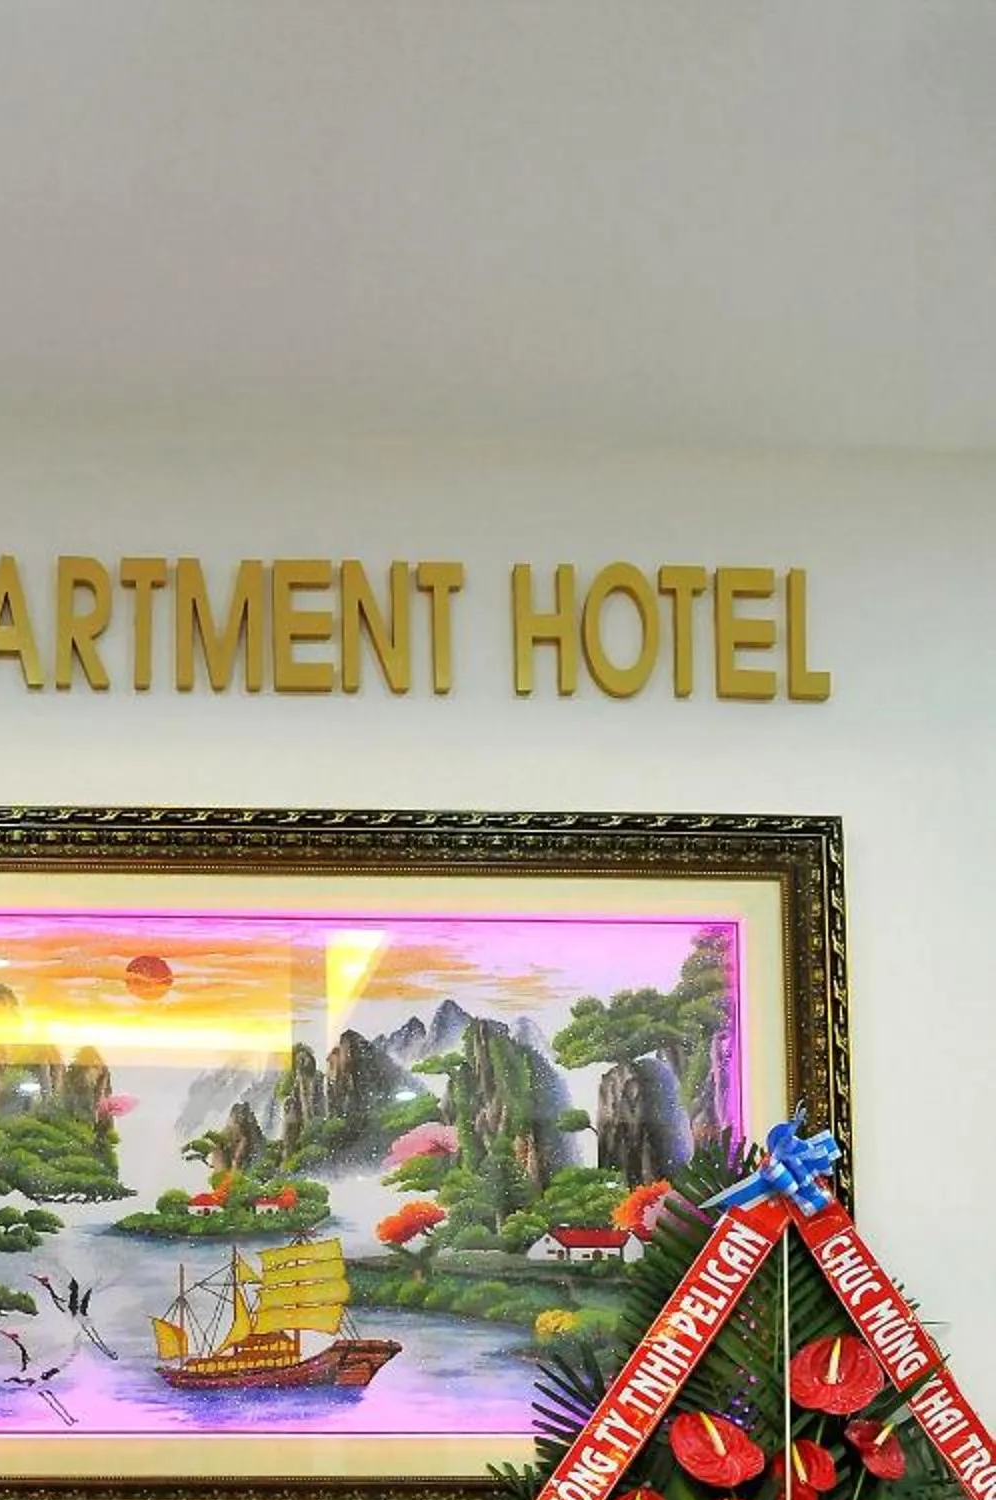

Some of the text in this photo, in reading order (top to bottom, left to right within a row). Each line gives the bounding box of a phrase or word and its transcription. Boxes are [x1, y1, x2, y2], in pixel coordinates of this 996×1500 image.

[511, 561, 831, 701] HOTEL
[676, 1218, 771, 1345] PELICAN
[817, 1229, 879, 1307] CHÚC
[617, 1329, 694, 1417] TNHH
[594, 1406, 643, 1454] TY
